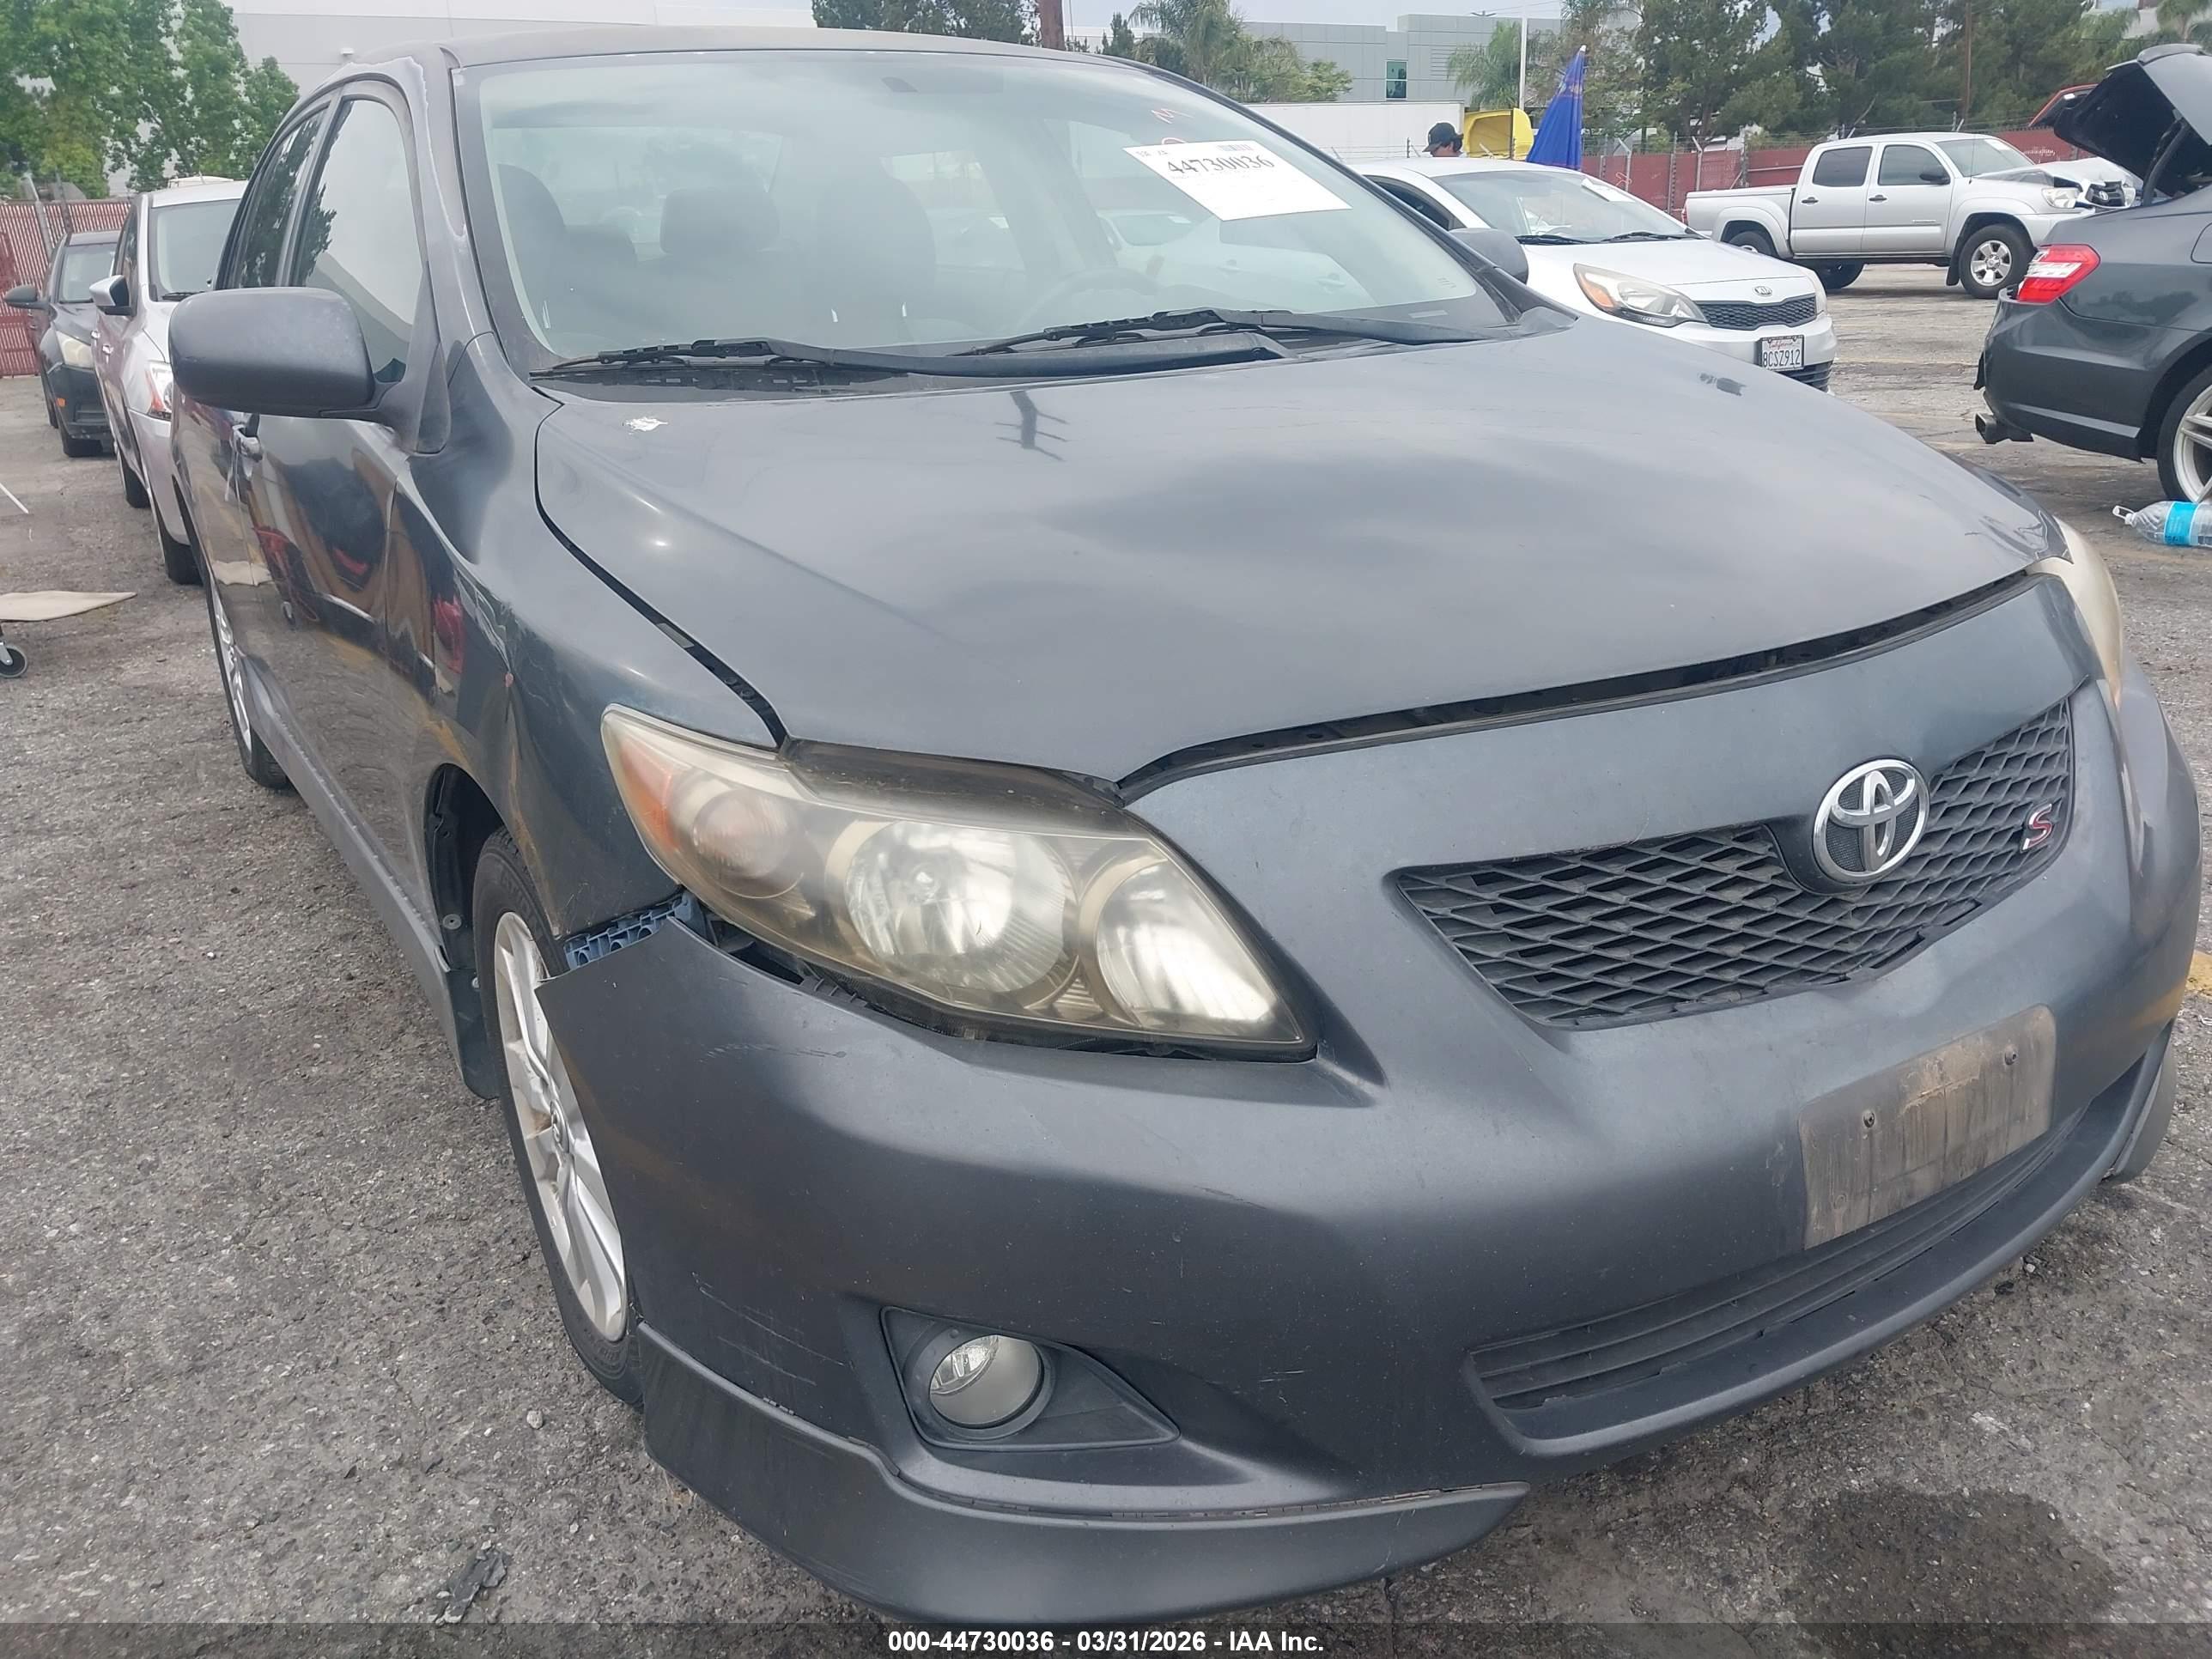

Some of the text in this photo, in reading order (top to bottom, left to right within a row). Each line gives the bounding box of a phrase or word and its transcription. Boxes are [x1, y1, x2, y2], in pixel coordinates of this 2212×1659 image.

[1167, 155, 1275, 173] 44730036
[1763, 349, 1801, 368] 8CSZ912
[2022, 803, 2053, 851] S
